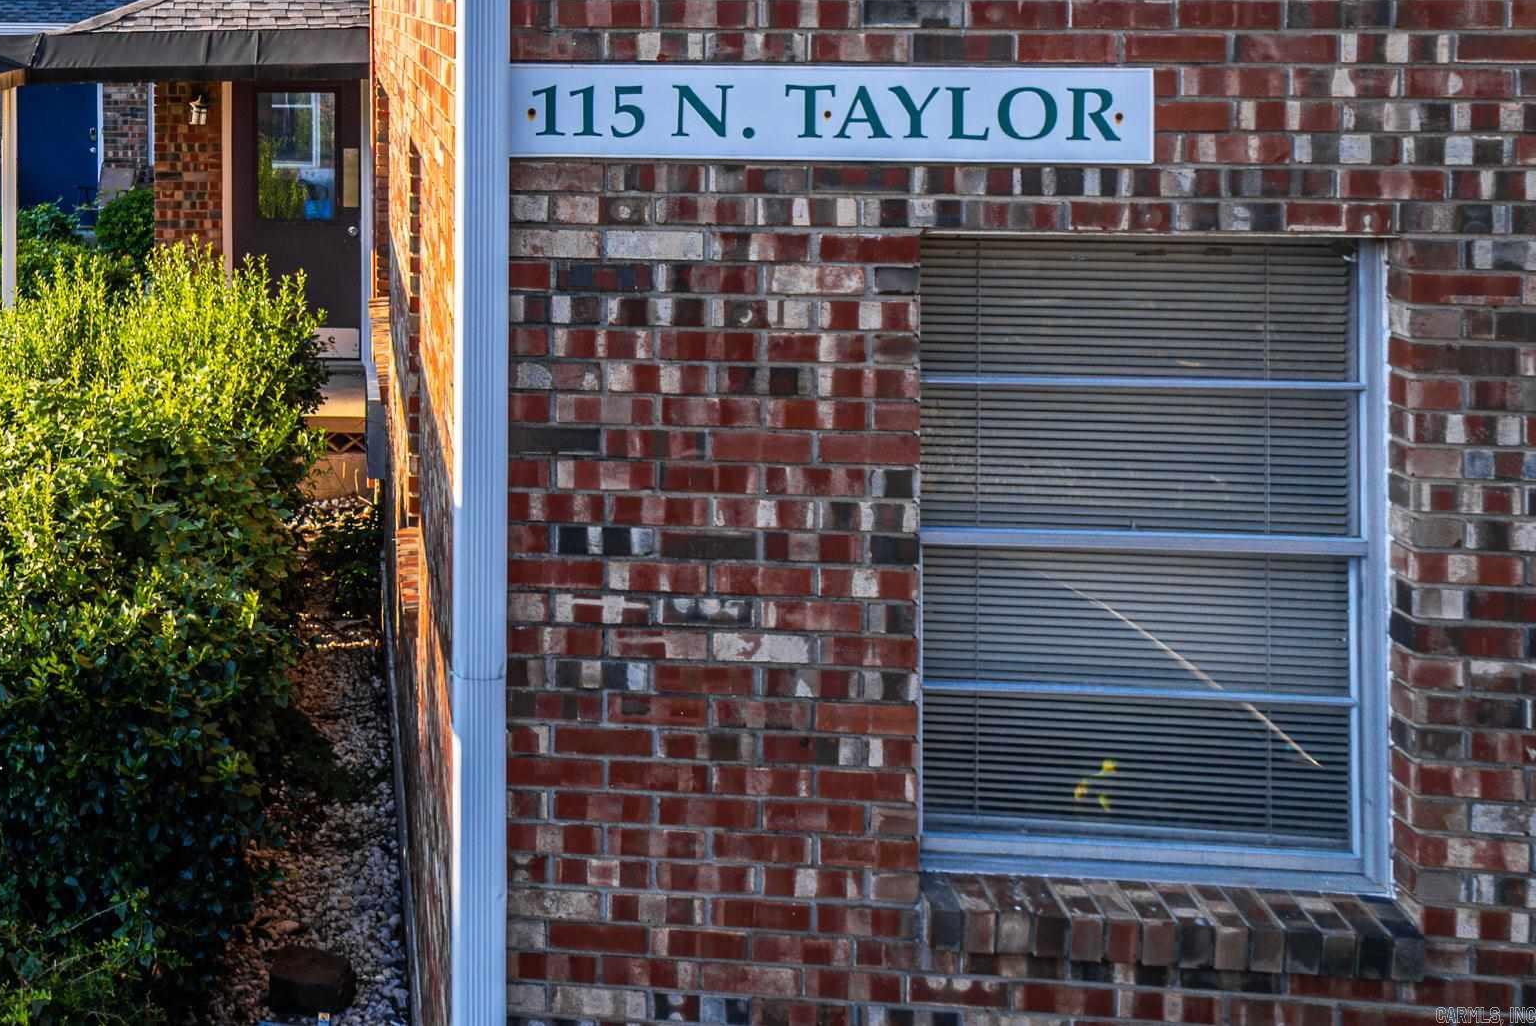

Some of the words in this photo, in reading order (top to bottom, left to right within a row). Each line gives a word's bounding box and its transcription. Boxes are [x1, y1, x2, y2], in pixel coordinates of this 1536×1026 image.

[531, 84, 647, 139] 115
[671, 84, 756, 139] N.
[785, 84, 1121, 142] TAYLOR
